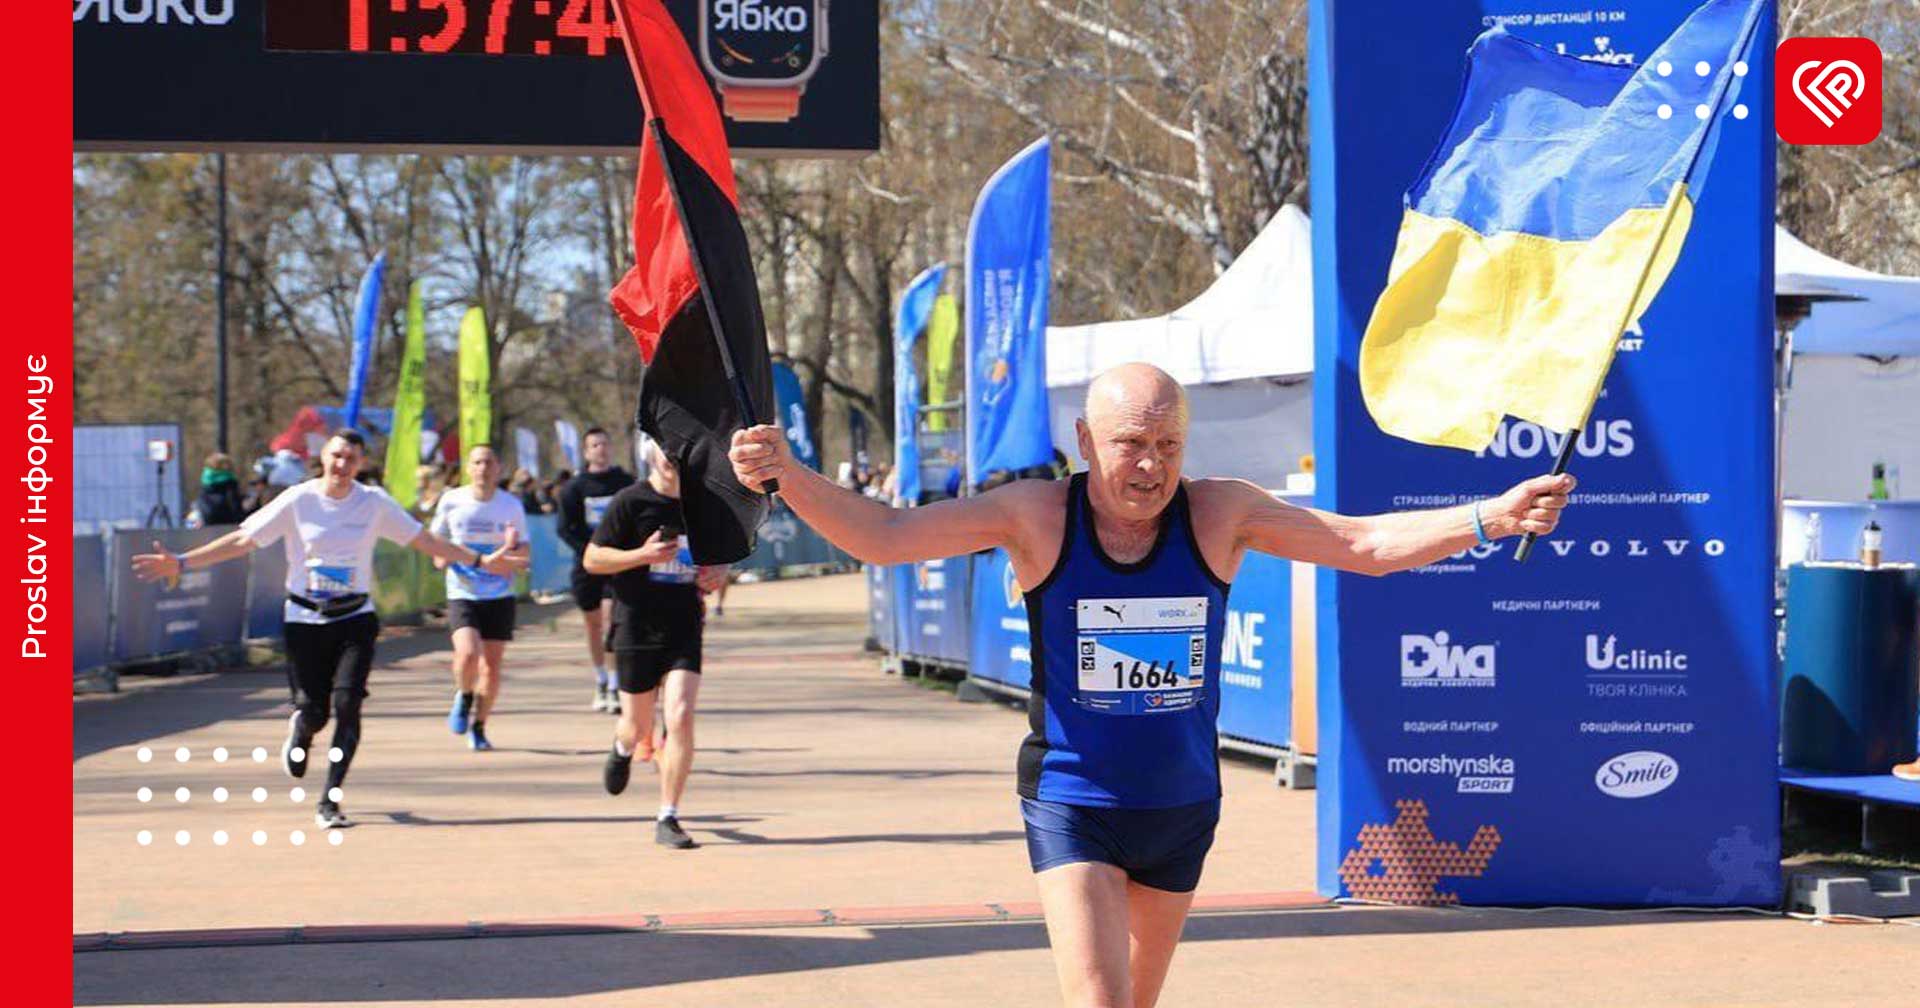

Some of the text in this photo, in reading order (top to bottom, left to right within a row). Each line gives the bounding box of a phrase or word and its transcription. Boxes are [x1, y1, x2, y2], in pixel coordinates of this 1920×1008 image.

[714, 0, 807, 31] Ябко
[1595, 12, 1607, 22] 10
[1609, 11, 1626, 21] КМ
[1475, 419, 1635, 458] NOVUS
[1393, 493, 1456, 506] СТРАХОВИЙ
[1567, 492, 1711, 504] АВТОМОБІЛЬНИЙ ПАРТНЕР
[1550, 539, 1725, 556] VOLVO
[1492, 600, 1600, 611] МЕДИЧНІ ПАРТНЕРИ
[1113, 660, 1178, 689] 1664
[1588, 683, 1687, 696] ТВОЯ КЛІНІКА
[1403, 720, 1499, 732] ВОДНИЙ ПАРТНЕР
[1580, 720, 1694, 733] ОФІЦІЙНИЙ ПАРТНЕР
[1387, 754, 1514, 777] morshynska
[1602, 759, 1672, 788] Smile
[1461, 780, 1510, 789] SPORT
